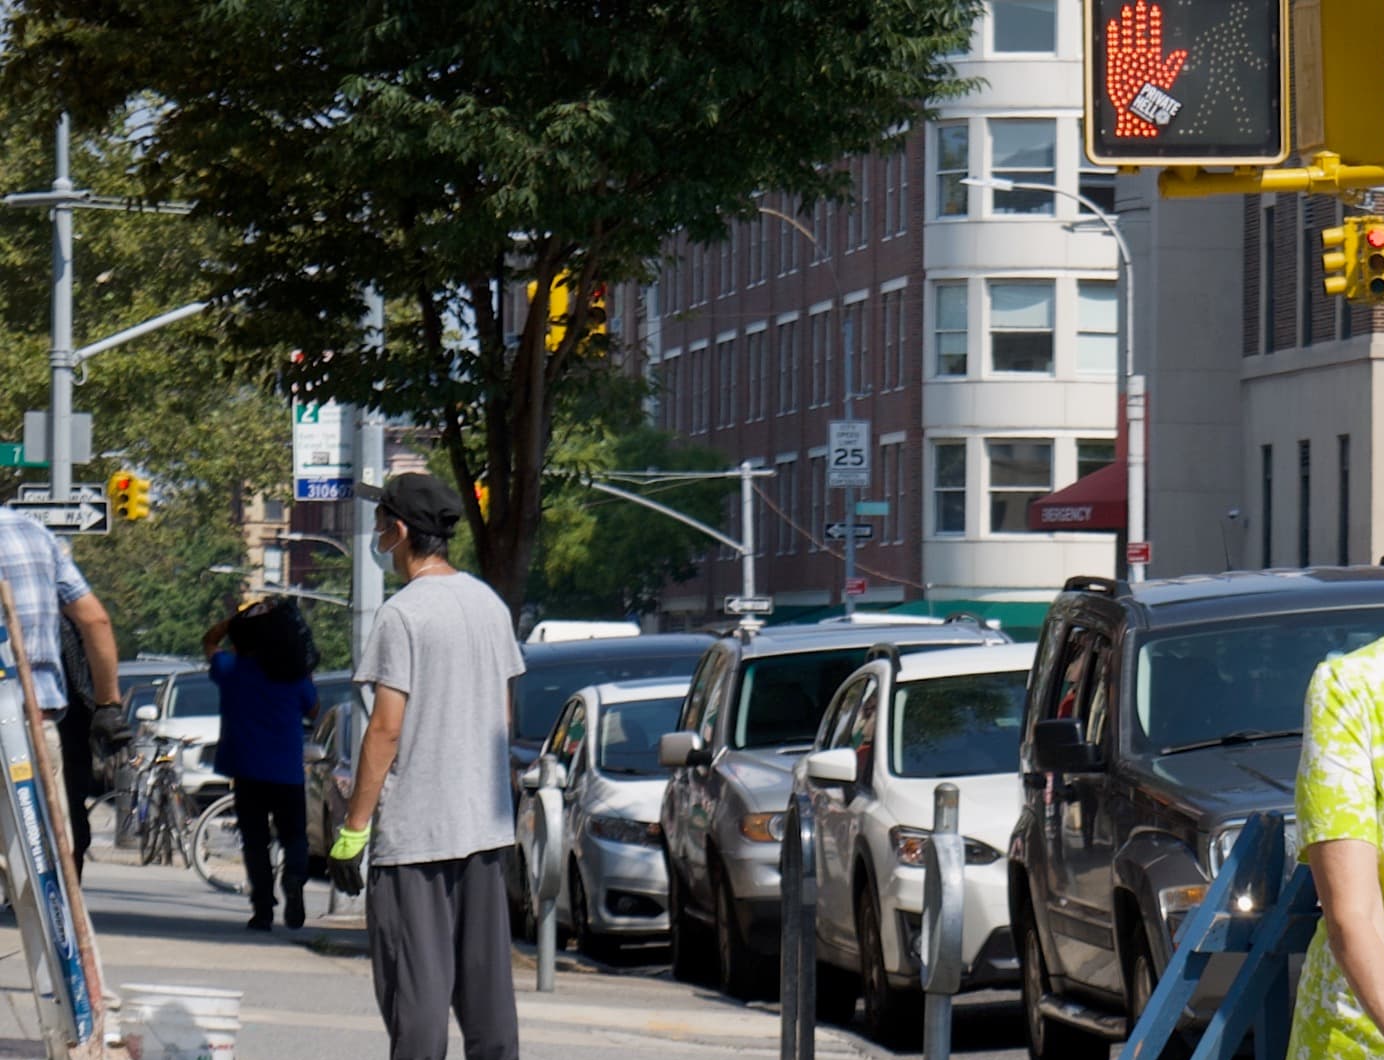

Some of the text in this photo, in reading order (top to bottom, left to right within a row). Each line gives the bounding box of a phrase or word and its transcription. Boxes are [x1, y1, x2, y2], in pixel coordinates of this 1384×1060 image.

[1140, 82, 1182, 117] PRIVATE
[833, 447, 865, 466] 25
[65, 510, 94, 523] WAY
